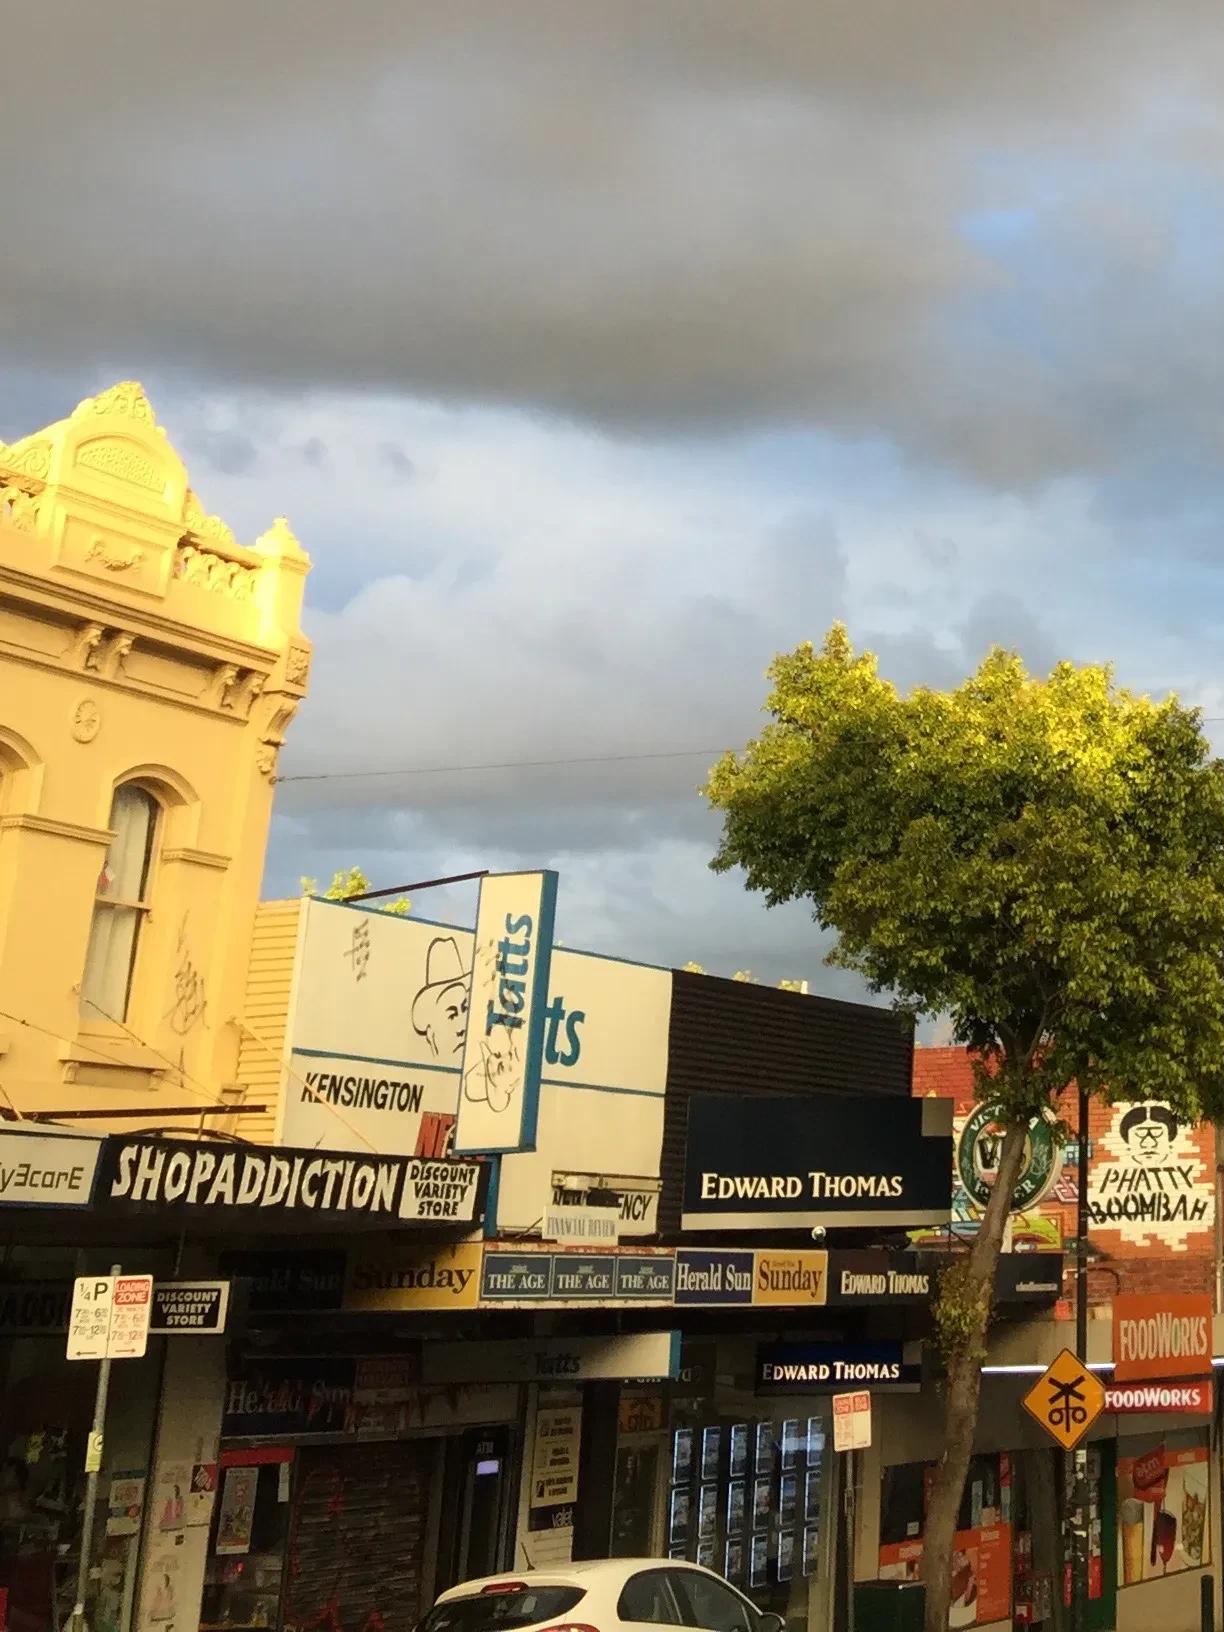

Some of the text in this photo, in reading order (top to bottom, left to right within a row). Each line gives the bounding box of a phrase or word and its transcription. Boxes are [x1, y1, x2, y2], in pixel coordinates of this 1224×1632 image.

[485, 913, 533, 1037] Tatts
[301, 1071, 424, 1113] KENSINGTON
[110, 1144, 400, 1212] SHOPADDICTION
[410, 1165, 476, 1185] DISCOUNT
[700, 1172, 903, 1199] EDWARD THOMAS
[1100, 1165, 1193, 1194] PHATTY
[414, 1182, 468, 1202] VARIETY
[417, 1201, 459, 1216] STORE
[1089, 1192, 1208, 1224] BOOMBAH
[352, 1261, 475, 1294] Sunday
[488, 1274, 546, 1289] THE AGE
[557, 1274, 610, 1289] THE AGE
[620, 1274, 670, 1290] THE AGE
[677, 1263, 751, 1292] Herald Sun
[758, 1259, 822, 1298] Sunday
[841, 1270, 929, 1295] EDWARD THOMAS
[94, 1282, 108, 1301] P
[117, 1292, 148, 1303] ZONE
[157, 1291, 218, 1302] DISCOUNT
[162, 1303, 212, 1314] VARIETY
[166, 1315, 204, 1325] STORE
[1120, 1312, 1207, 1361] FOODWORKS
[763, 1361, 900, 1381] EDWARD THOMAS
[1105, 1385, 1201, 1408] FOODWORKS
